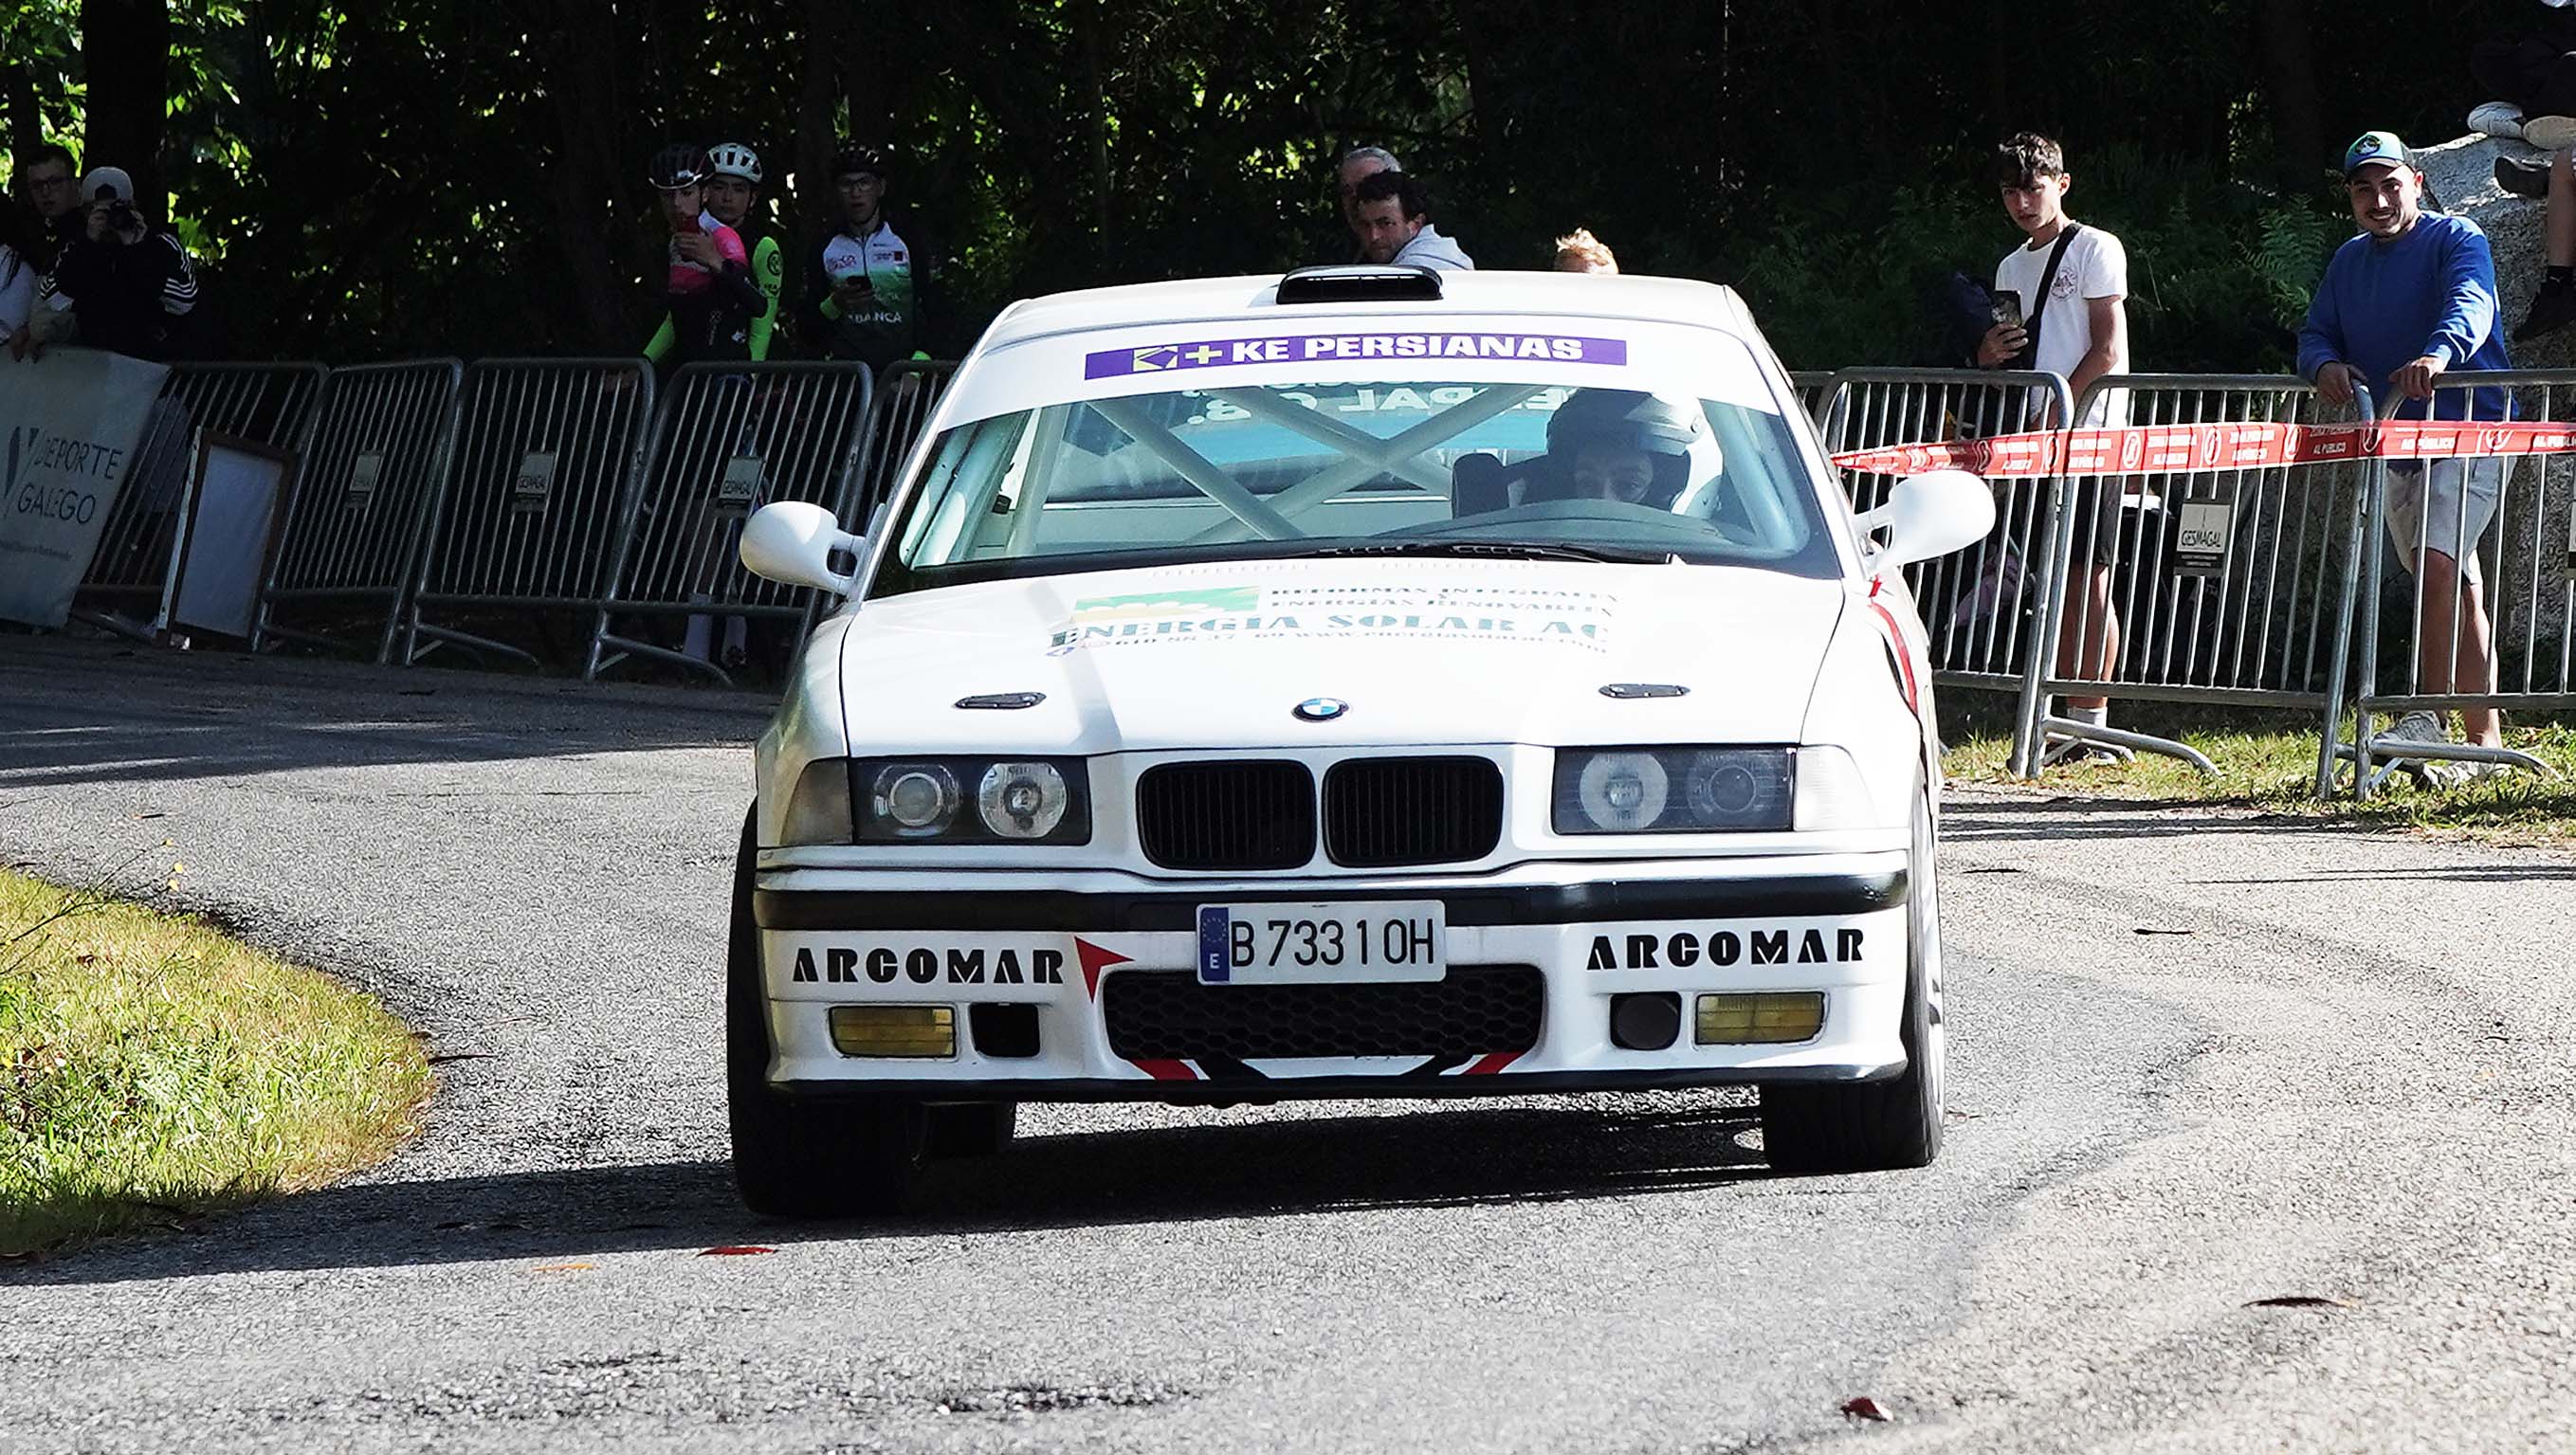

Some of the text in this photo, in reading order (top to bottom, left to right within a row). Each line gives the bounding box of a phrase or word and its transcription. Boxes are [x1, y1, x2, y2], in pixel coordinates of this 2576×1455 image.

[1305, 336, 1583, 360] PERSIANAS
[17, 482, 97, 524] GALEGO
[1326, 614, 1517, 632] SOLAR
[1209, 953, 1221, 970] E
